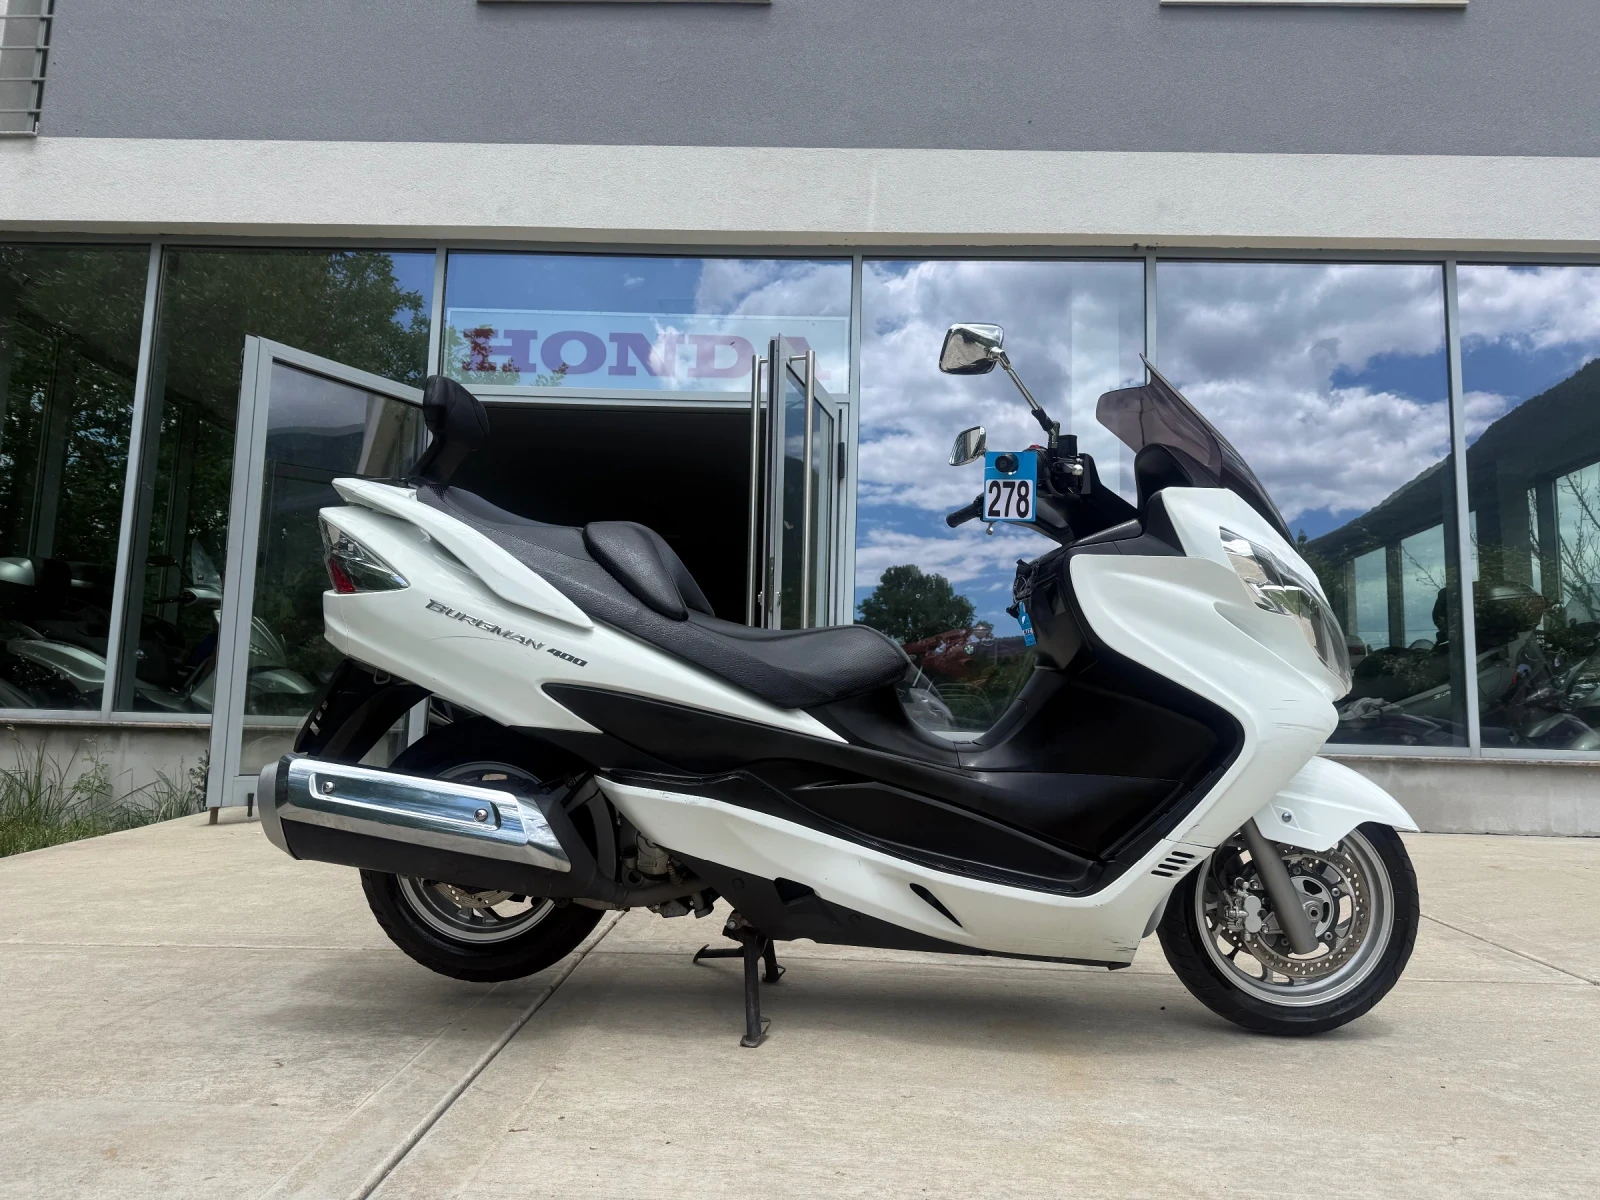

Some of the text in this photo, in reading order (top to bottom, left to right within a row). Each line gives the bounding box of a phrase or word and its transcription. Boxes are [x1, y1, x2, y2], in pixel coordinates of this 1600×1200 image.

[988, 481, 1029, 518] 278
[425, 599, 588, 667] BURGMAN 400
